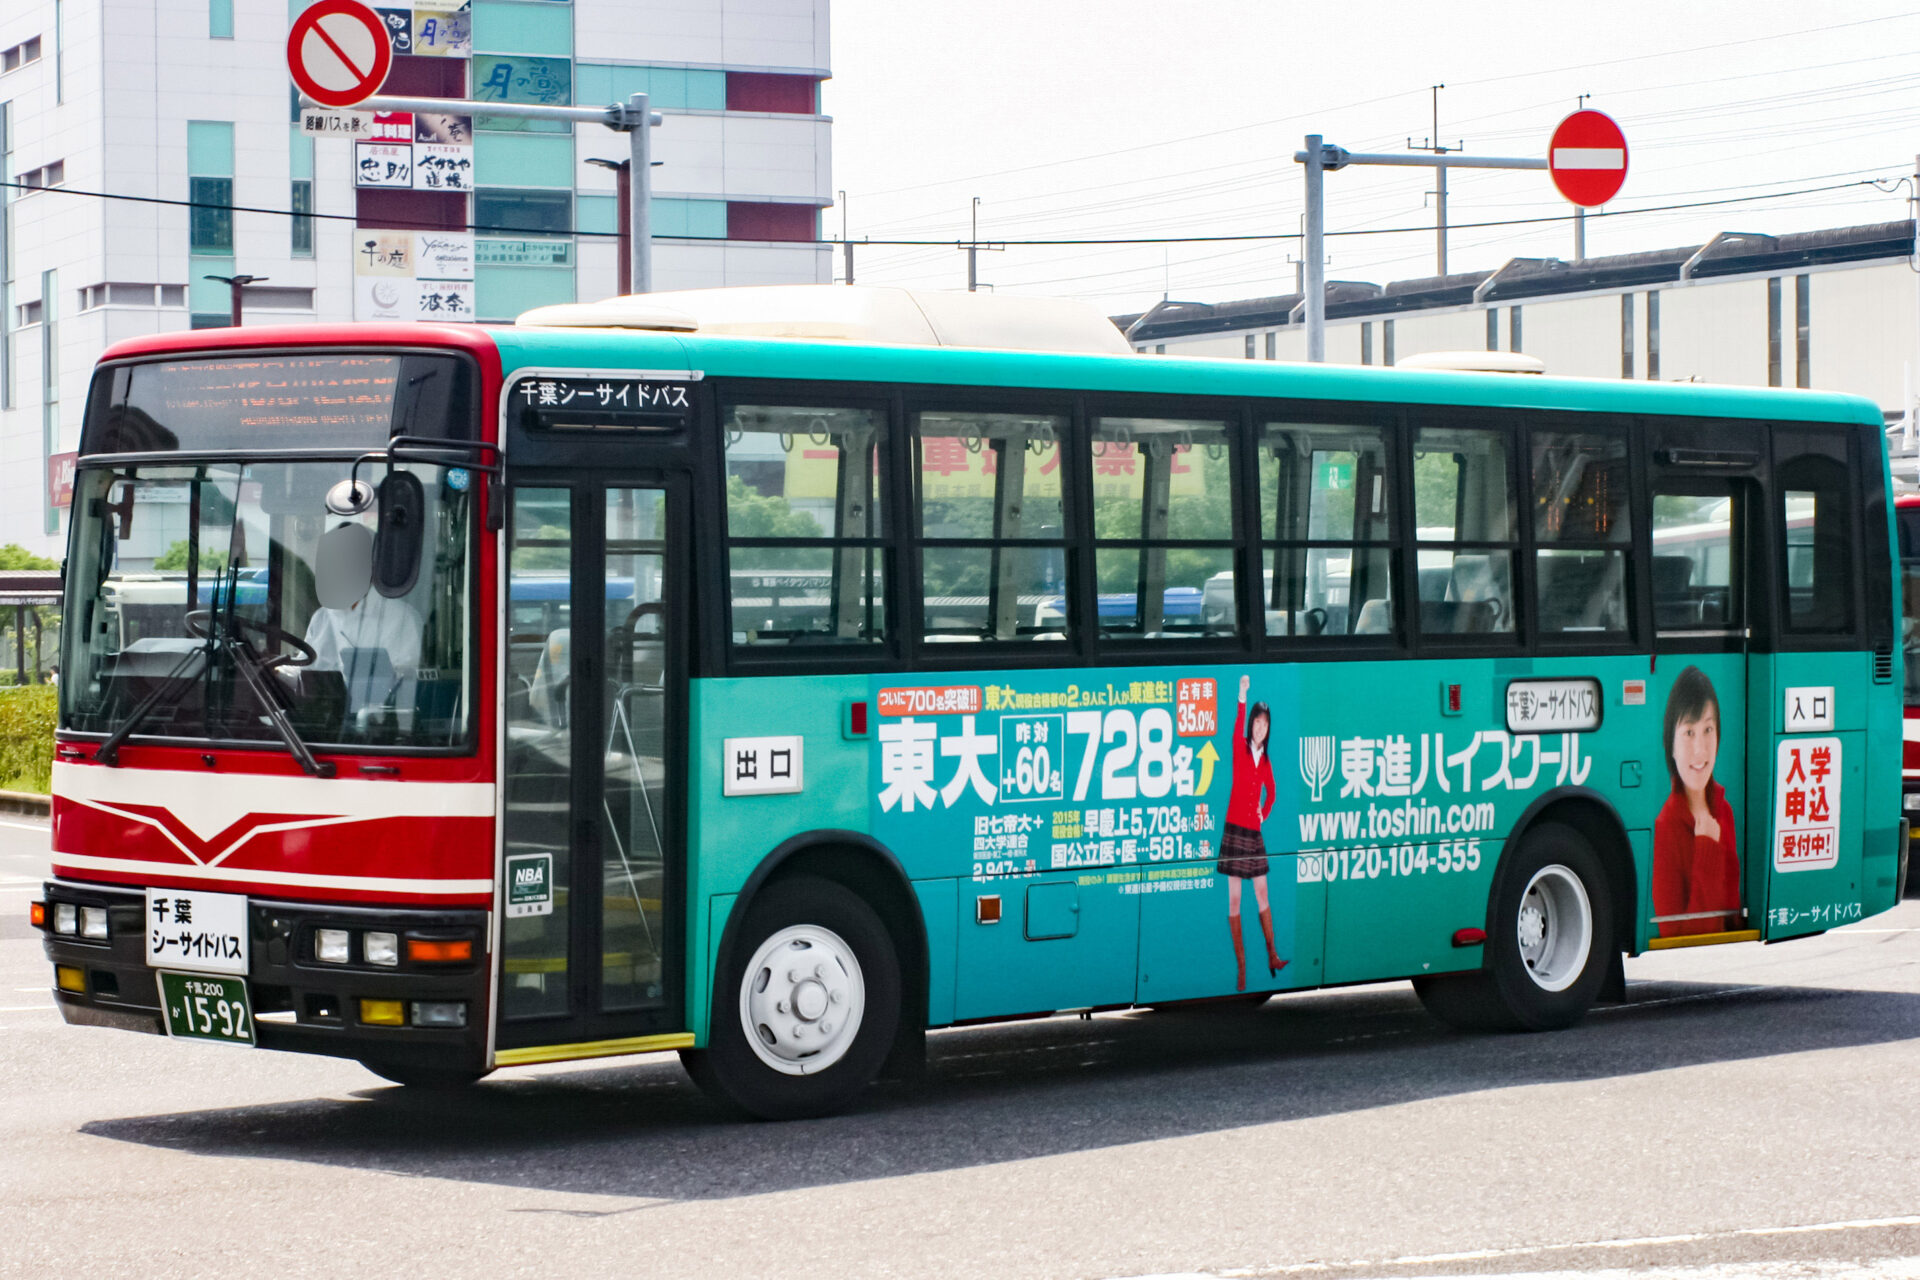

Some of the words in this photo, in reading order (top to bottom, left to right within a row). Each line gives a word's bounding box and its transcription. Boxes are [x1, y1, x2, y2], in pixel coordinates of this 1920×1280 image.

[306, 115, 368, 132] 路線バスを除く
[360, 158, 409, 181] 忠助
[417, 155, 470, 171] さかなや
[426, 171, 461, 188] 道場
[361, 240, 406, 268] 千の庭
[419, 292, 464, 312] 波奈
[520, 381, 689, 407] 千葉シーサイドバス
[880, 688, 977, 712] ついに700名突破!!
[1179, 682, 1213, 700] 占有率
[1178, 703, 1215, 733] 35.0%
[1508, 688, 1597, 722] 千葉シーサイドバス
[1793, 696, 1826, 720] 入口
[1015, 721, 1048, 744] 昨対
[737, 748, 790, 780] 出口
[878, 715, 998, 813] 東大
[1066, 708, 1194, 801] 728名
[1340, 730, 1592, 799] 東進ハイスクール
[1785, 746, 1831, 785] 入学
[1003, 745, 1061, 795] +60名
[1052, 810, 1080, 824] 2015年
[1785, 785, 1830, 825] 申込
[1299, 798, 1495, 842] www.toshin.com
[973, 833, 1028, 850] 四大学連合
[1782, 833, 1831, 858] 受付中!
[1323, 837, 1481, 882] 0120-104-555
[515, 867, 543, 883] NBA
[152, 898, 192, 924] 千葉
[1768, 902, 1862, 927] 千葉シーサイドバス
[152, 930, 242, 959] シーサイドバス
[185, 981, 203, 994] 千葉
[203, 983, 224, 997] 200
[184, 995, 249, 1038] 15-92
